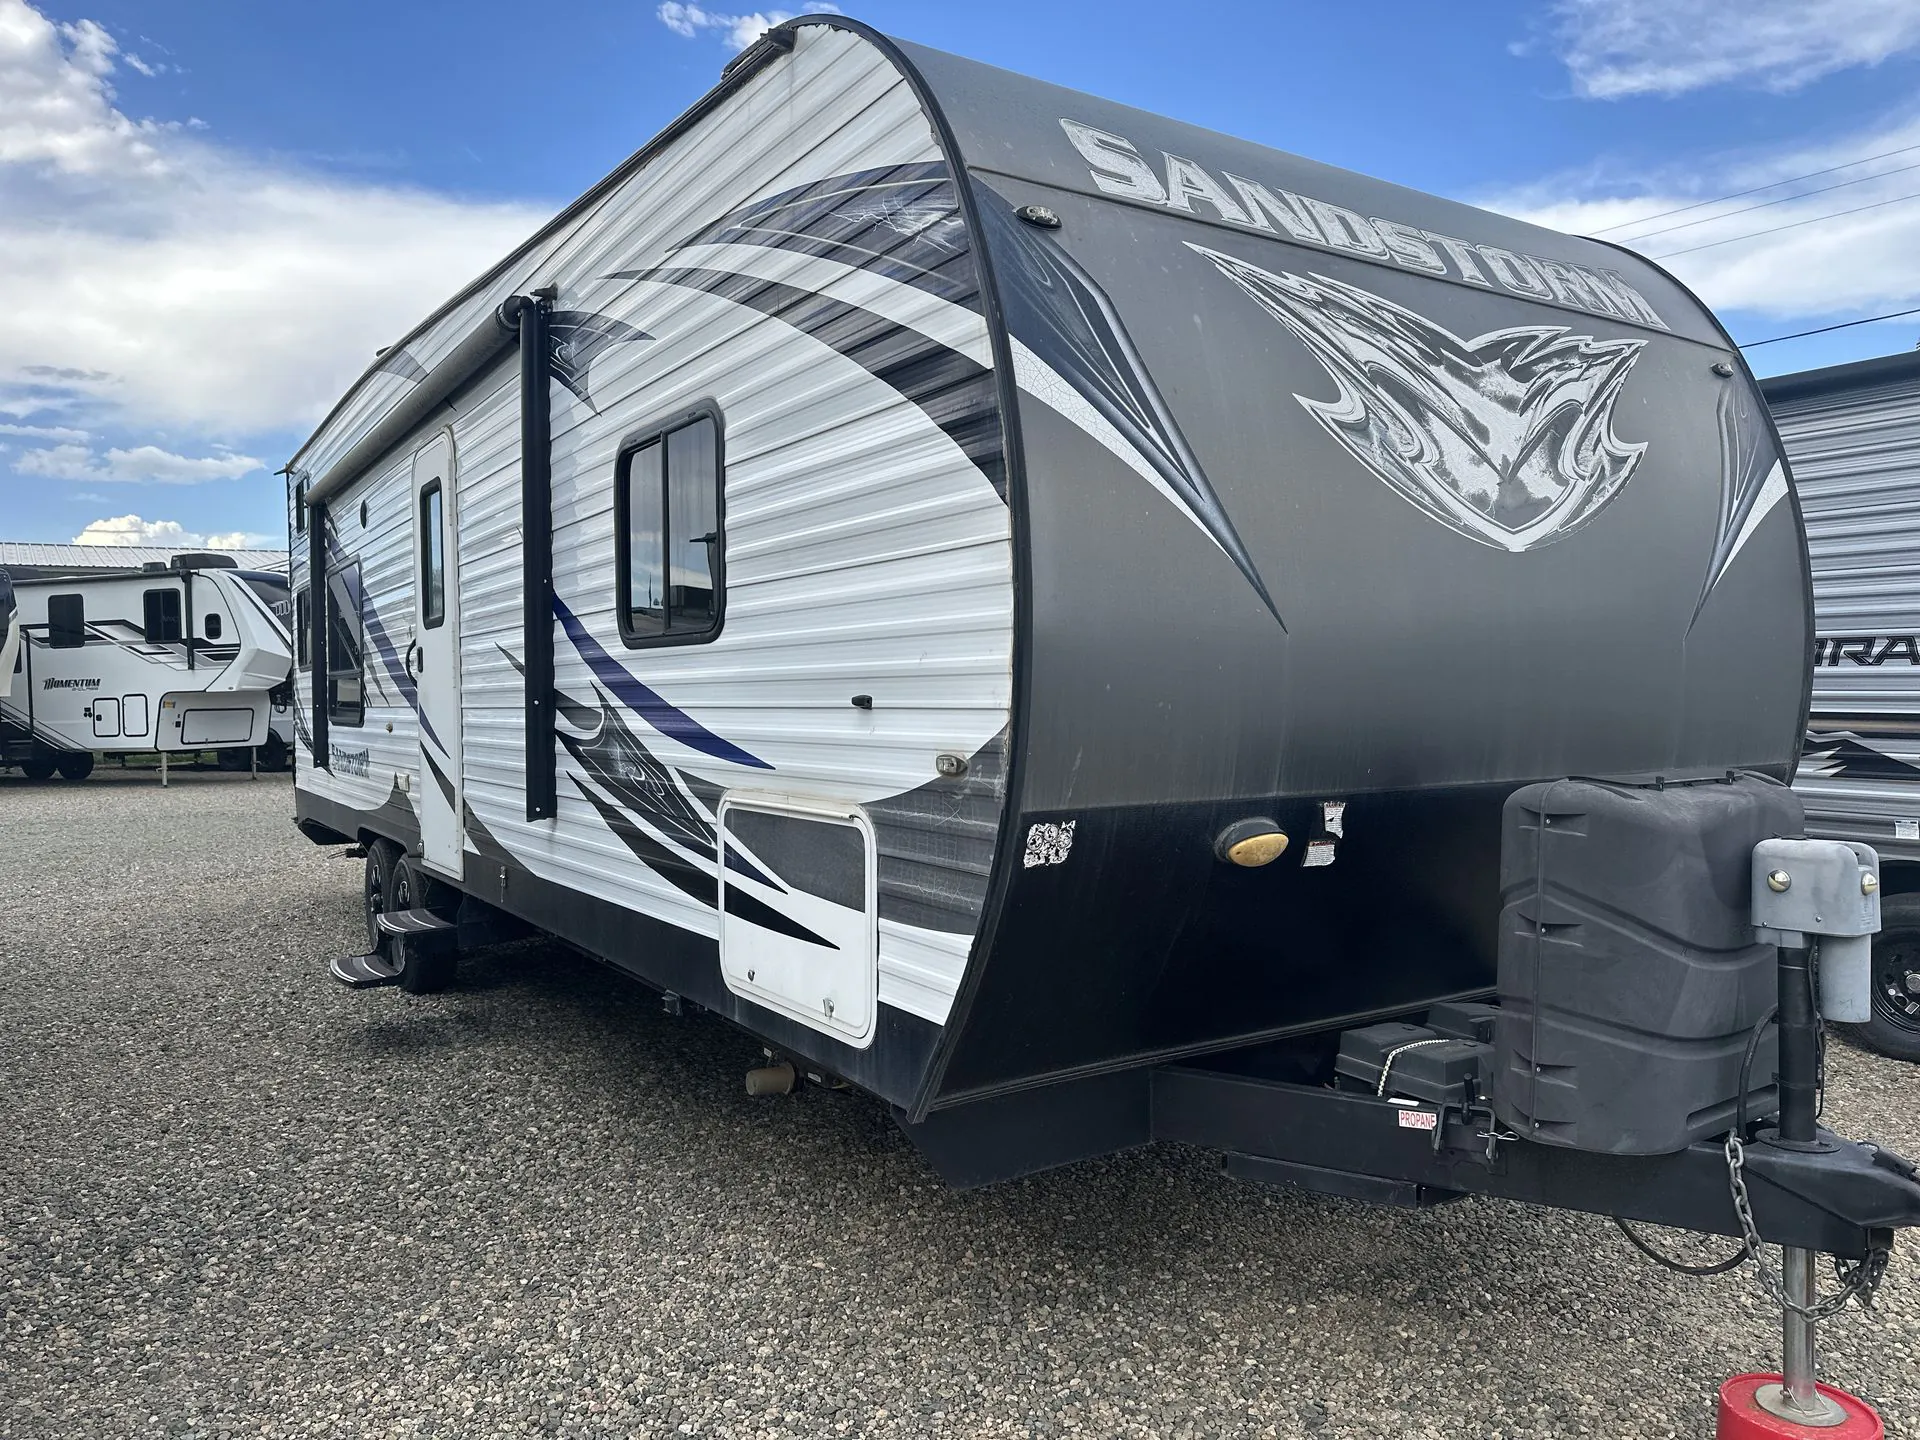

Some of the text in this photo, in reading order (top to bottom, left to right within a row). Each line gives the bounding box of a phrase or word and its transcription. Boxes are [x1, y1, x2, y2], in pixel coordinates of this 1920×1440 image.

[1059, 117, 1671, 331] SANDSTORM
[43, 678, 100, 690] MOMENTUM
[1400, 1111, 1435, 1128] PROPANE
